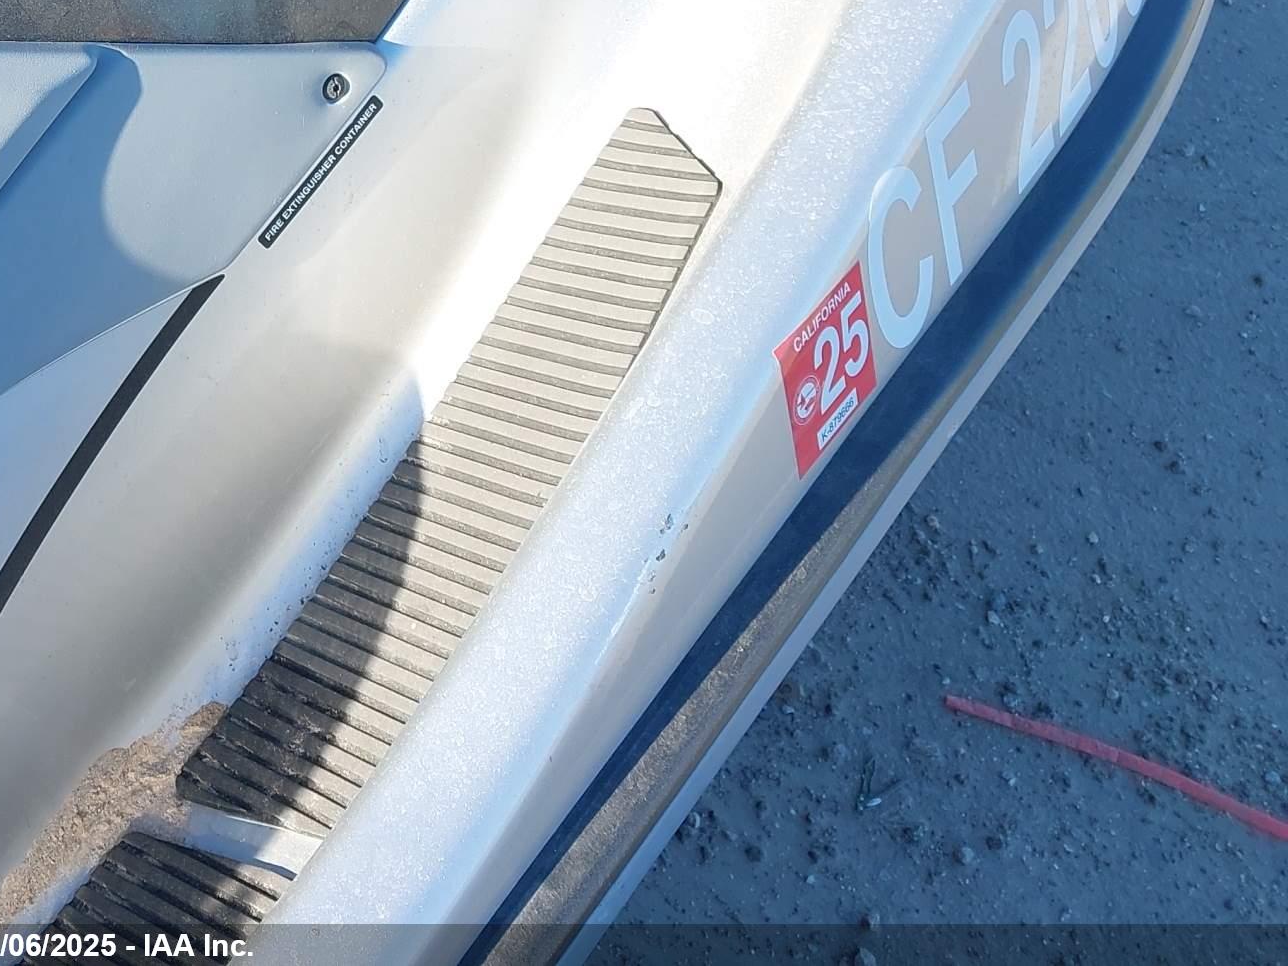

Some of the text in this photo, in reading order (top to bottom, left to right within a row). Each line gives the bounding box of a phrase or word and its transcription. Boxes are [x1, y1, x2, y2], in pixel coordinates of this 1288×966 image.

[264, 102, 378, 242] FIRE EXTINGUISHER CONTAINER
[868, 80, 978, 349] CF
[793, 281, 851, 353] CALIFORNIA
[814, 289, 870, 416] 25
